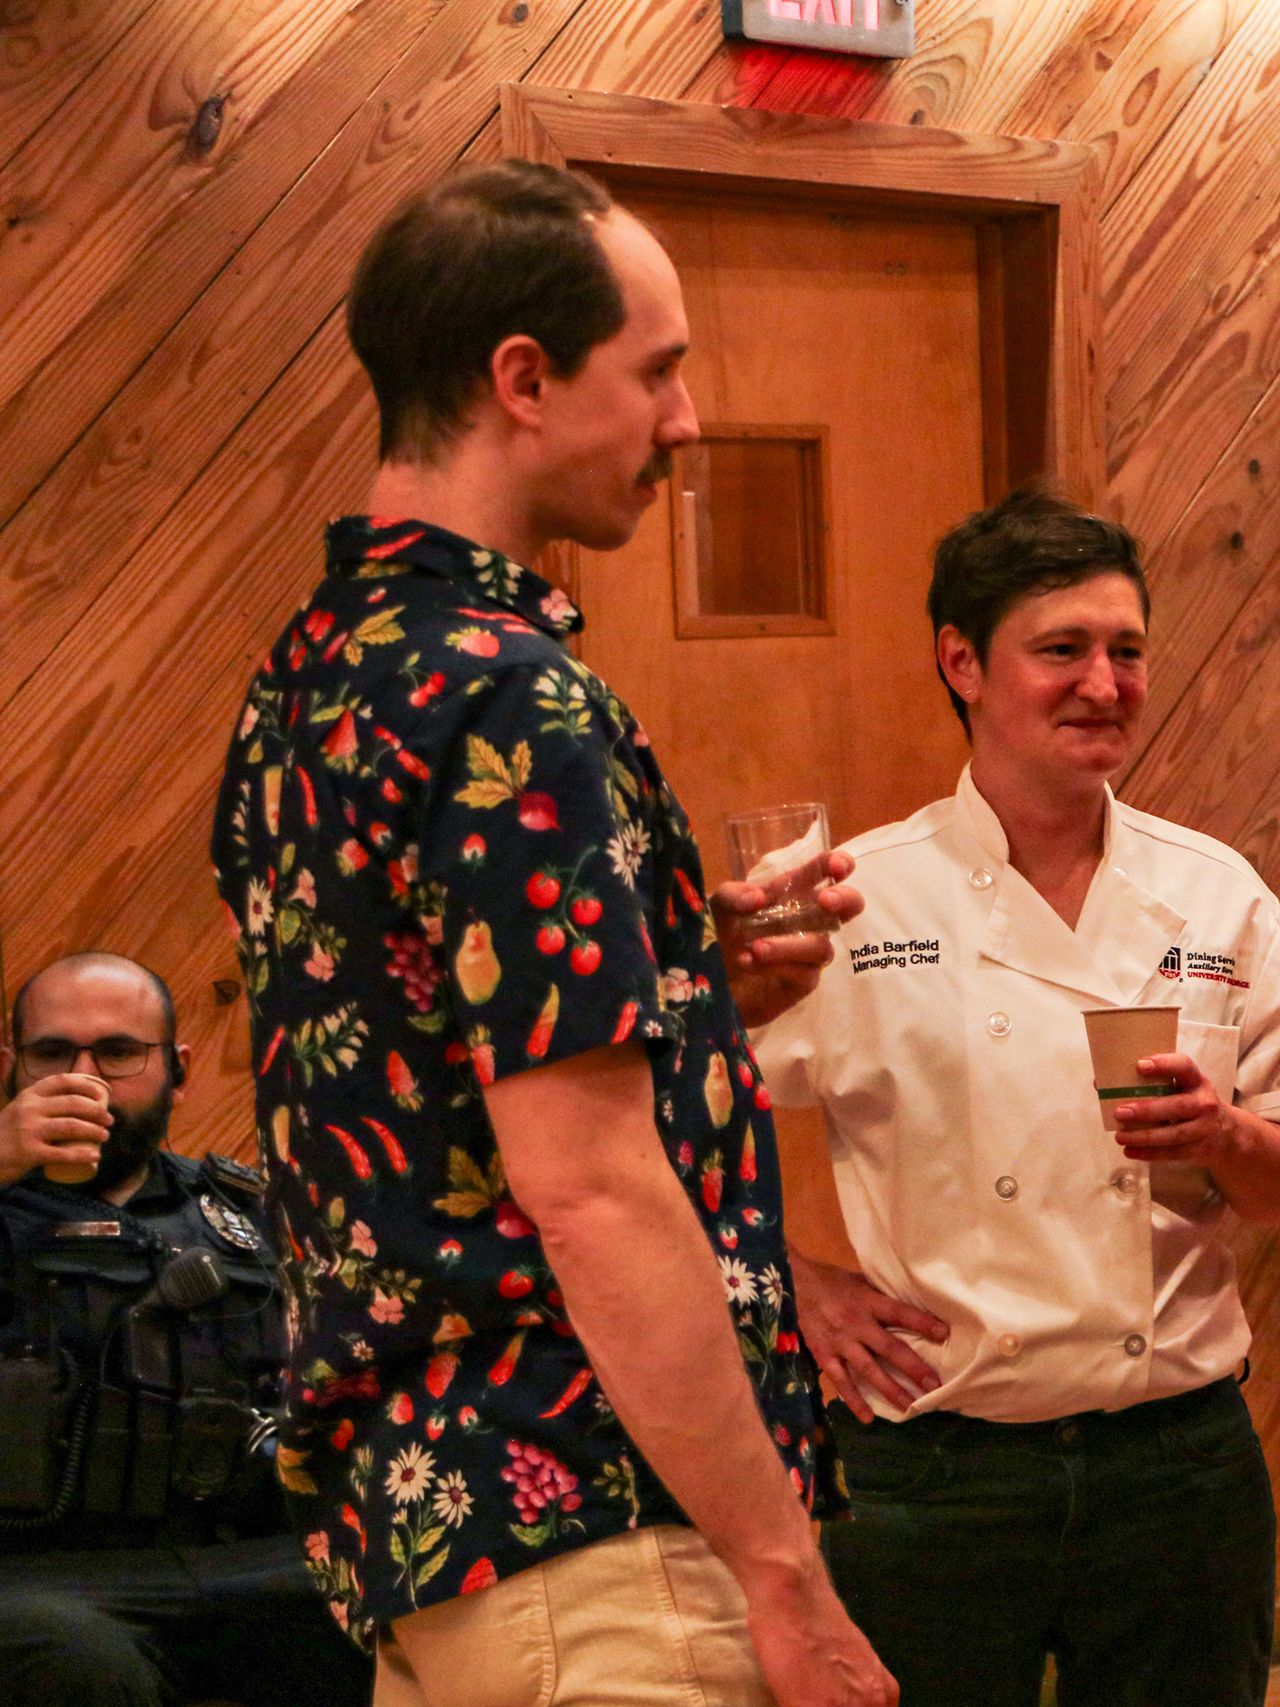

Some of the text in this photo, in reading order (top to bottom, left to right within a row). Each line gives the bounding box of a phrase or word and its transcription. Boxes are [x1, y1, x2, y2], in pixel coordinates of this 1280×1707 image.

[850, 939, 939, 960] India Barfield
[1187, 952, 1217, 964] Dining
[853, 953, 940, 974] Managing Chef
